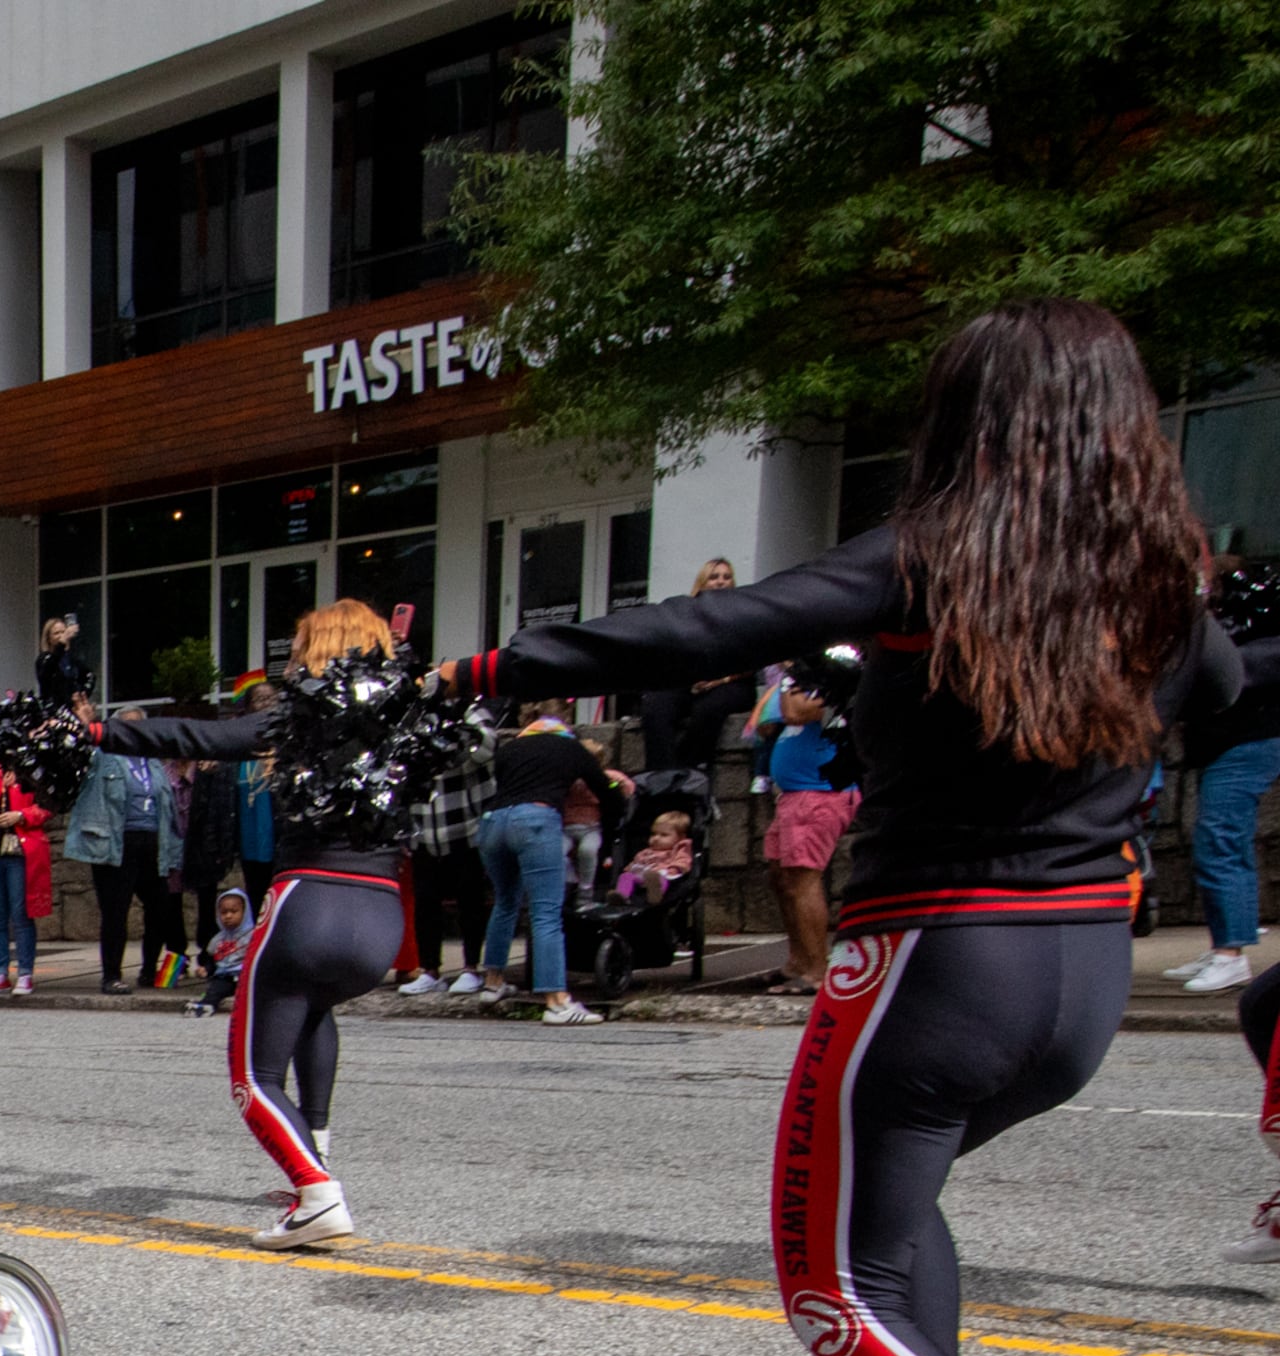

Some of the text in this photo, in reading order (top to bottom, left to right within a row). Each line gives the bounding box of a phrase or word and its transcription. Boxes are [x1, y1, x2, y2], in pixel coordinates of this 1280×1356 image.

[302, 316, 466, 414] TASTE
[781, 1008, 839, 1278] ATLANTA HAWKS
